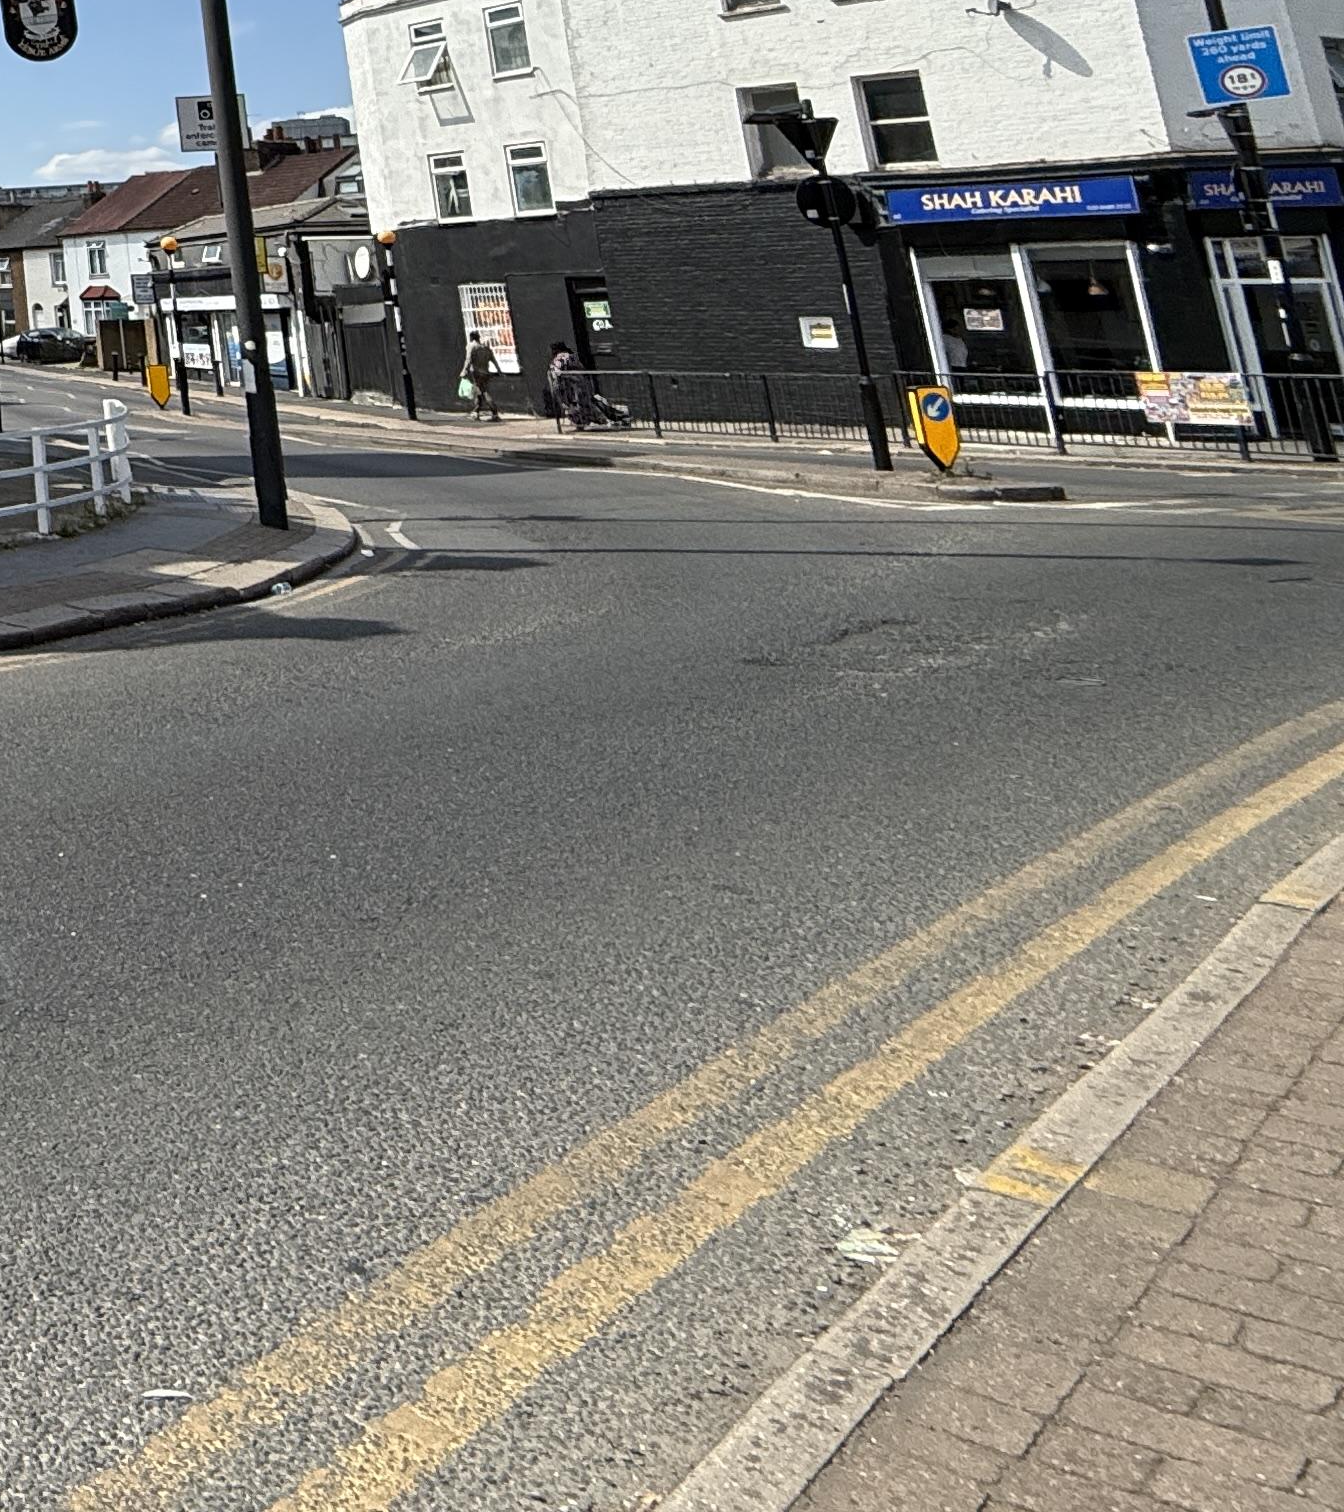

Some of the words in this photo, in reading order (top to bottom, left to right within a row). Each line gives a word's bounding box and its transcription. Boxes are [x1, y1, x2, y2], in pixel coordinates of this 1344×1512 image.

[1192, 34, 1238, 48] Weight
[1240, 29, 1270, 41] limit
[1230, 41, 1267, 54] yards
[1217, 51, 1256, 64] ahead
[1268, 180, 1326, 194] ARAHI
[920, 190, 983, 211] SHAH
[988, 185, 1083, 208] KARAHI
